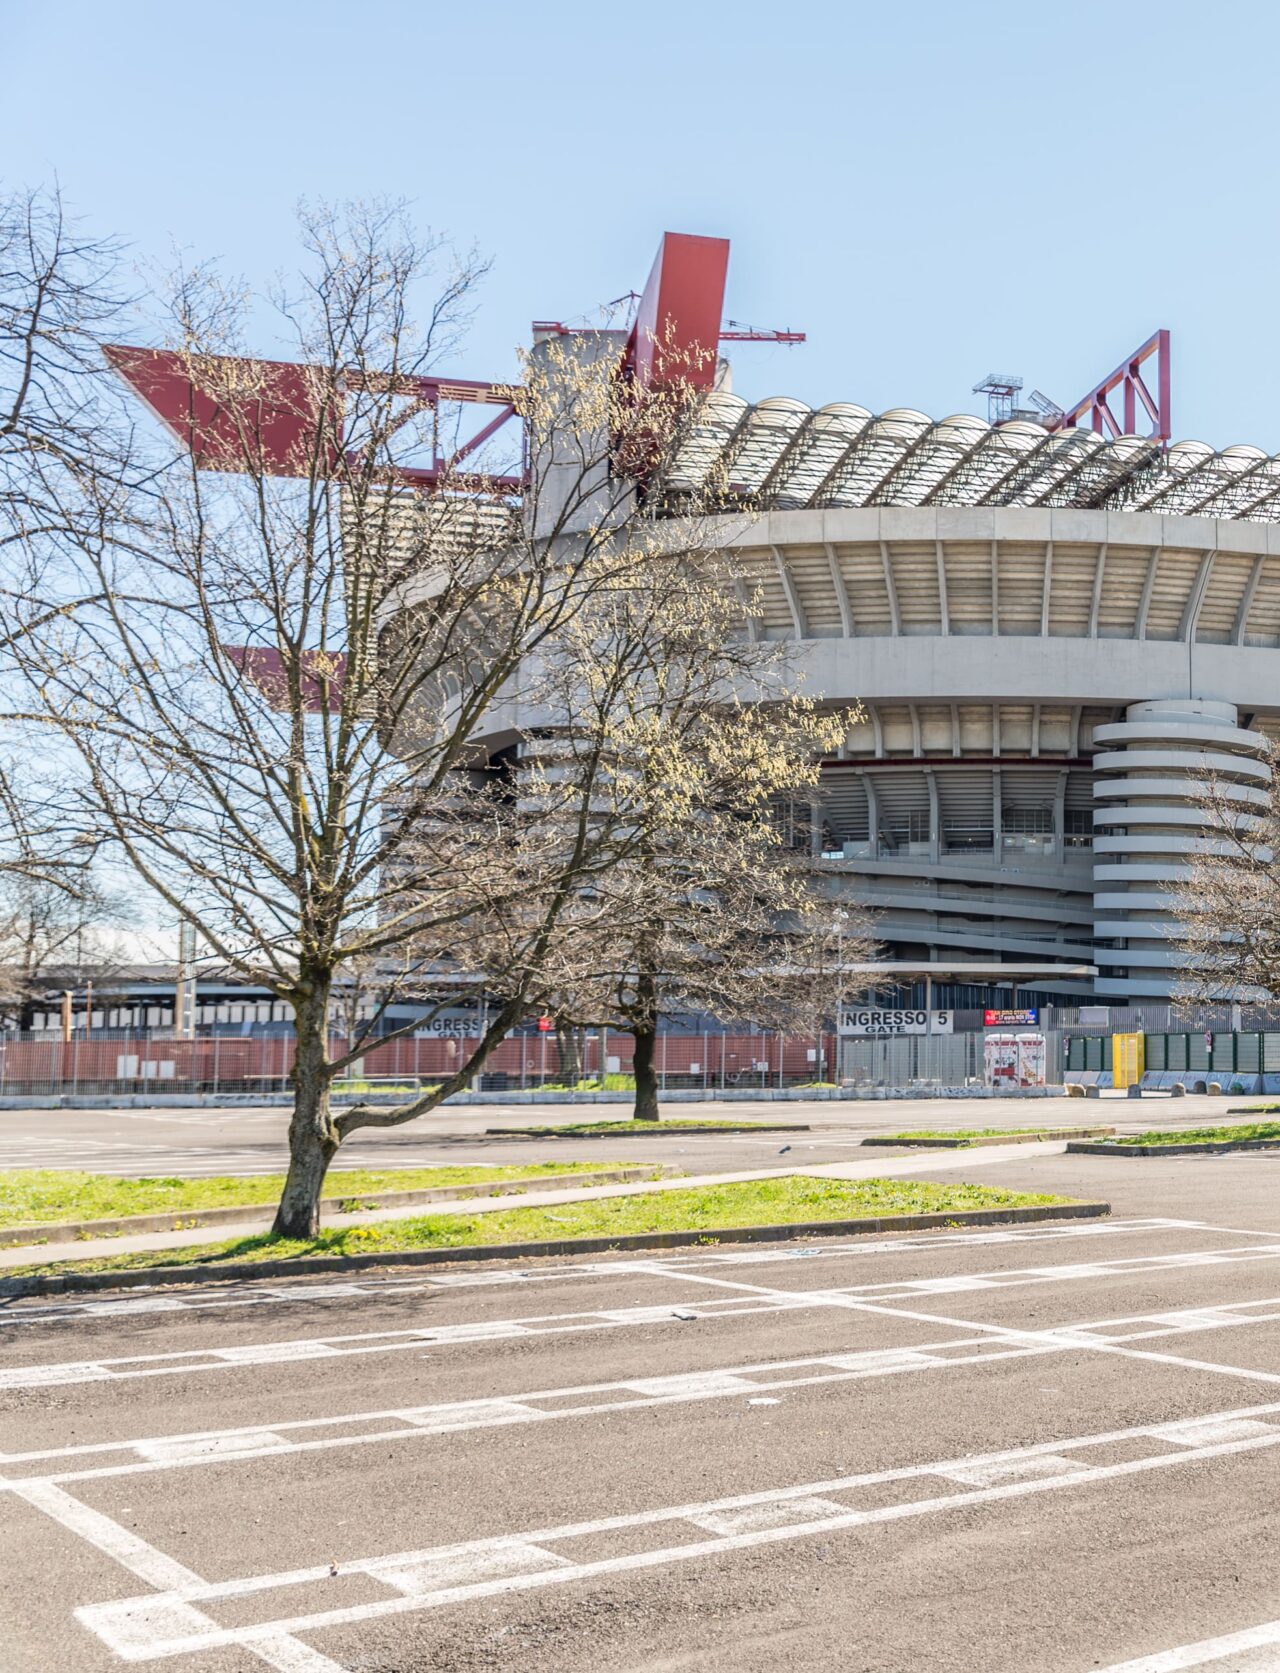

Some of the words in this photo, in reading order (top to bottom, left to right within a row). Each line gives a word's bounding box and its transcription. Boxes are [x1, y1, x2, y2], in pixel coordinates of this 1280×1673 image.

[840, 1011, 927, 1026] INGRESSO
[938, 1011, 948, 1025] 5
[865, 1025, 906, 1033] GATE
